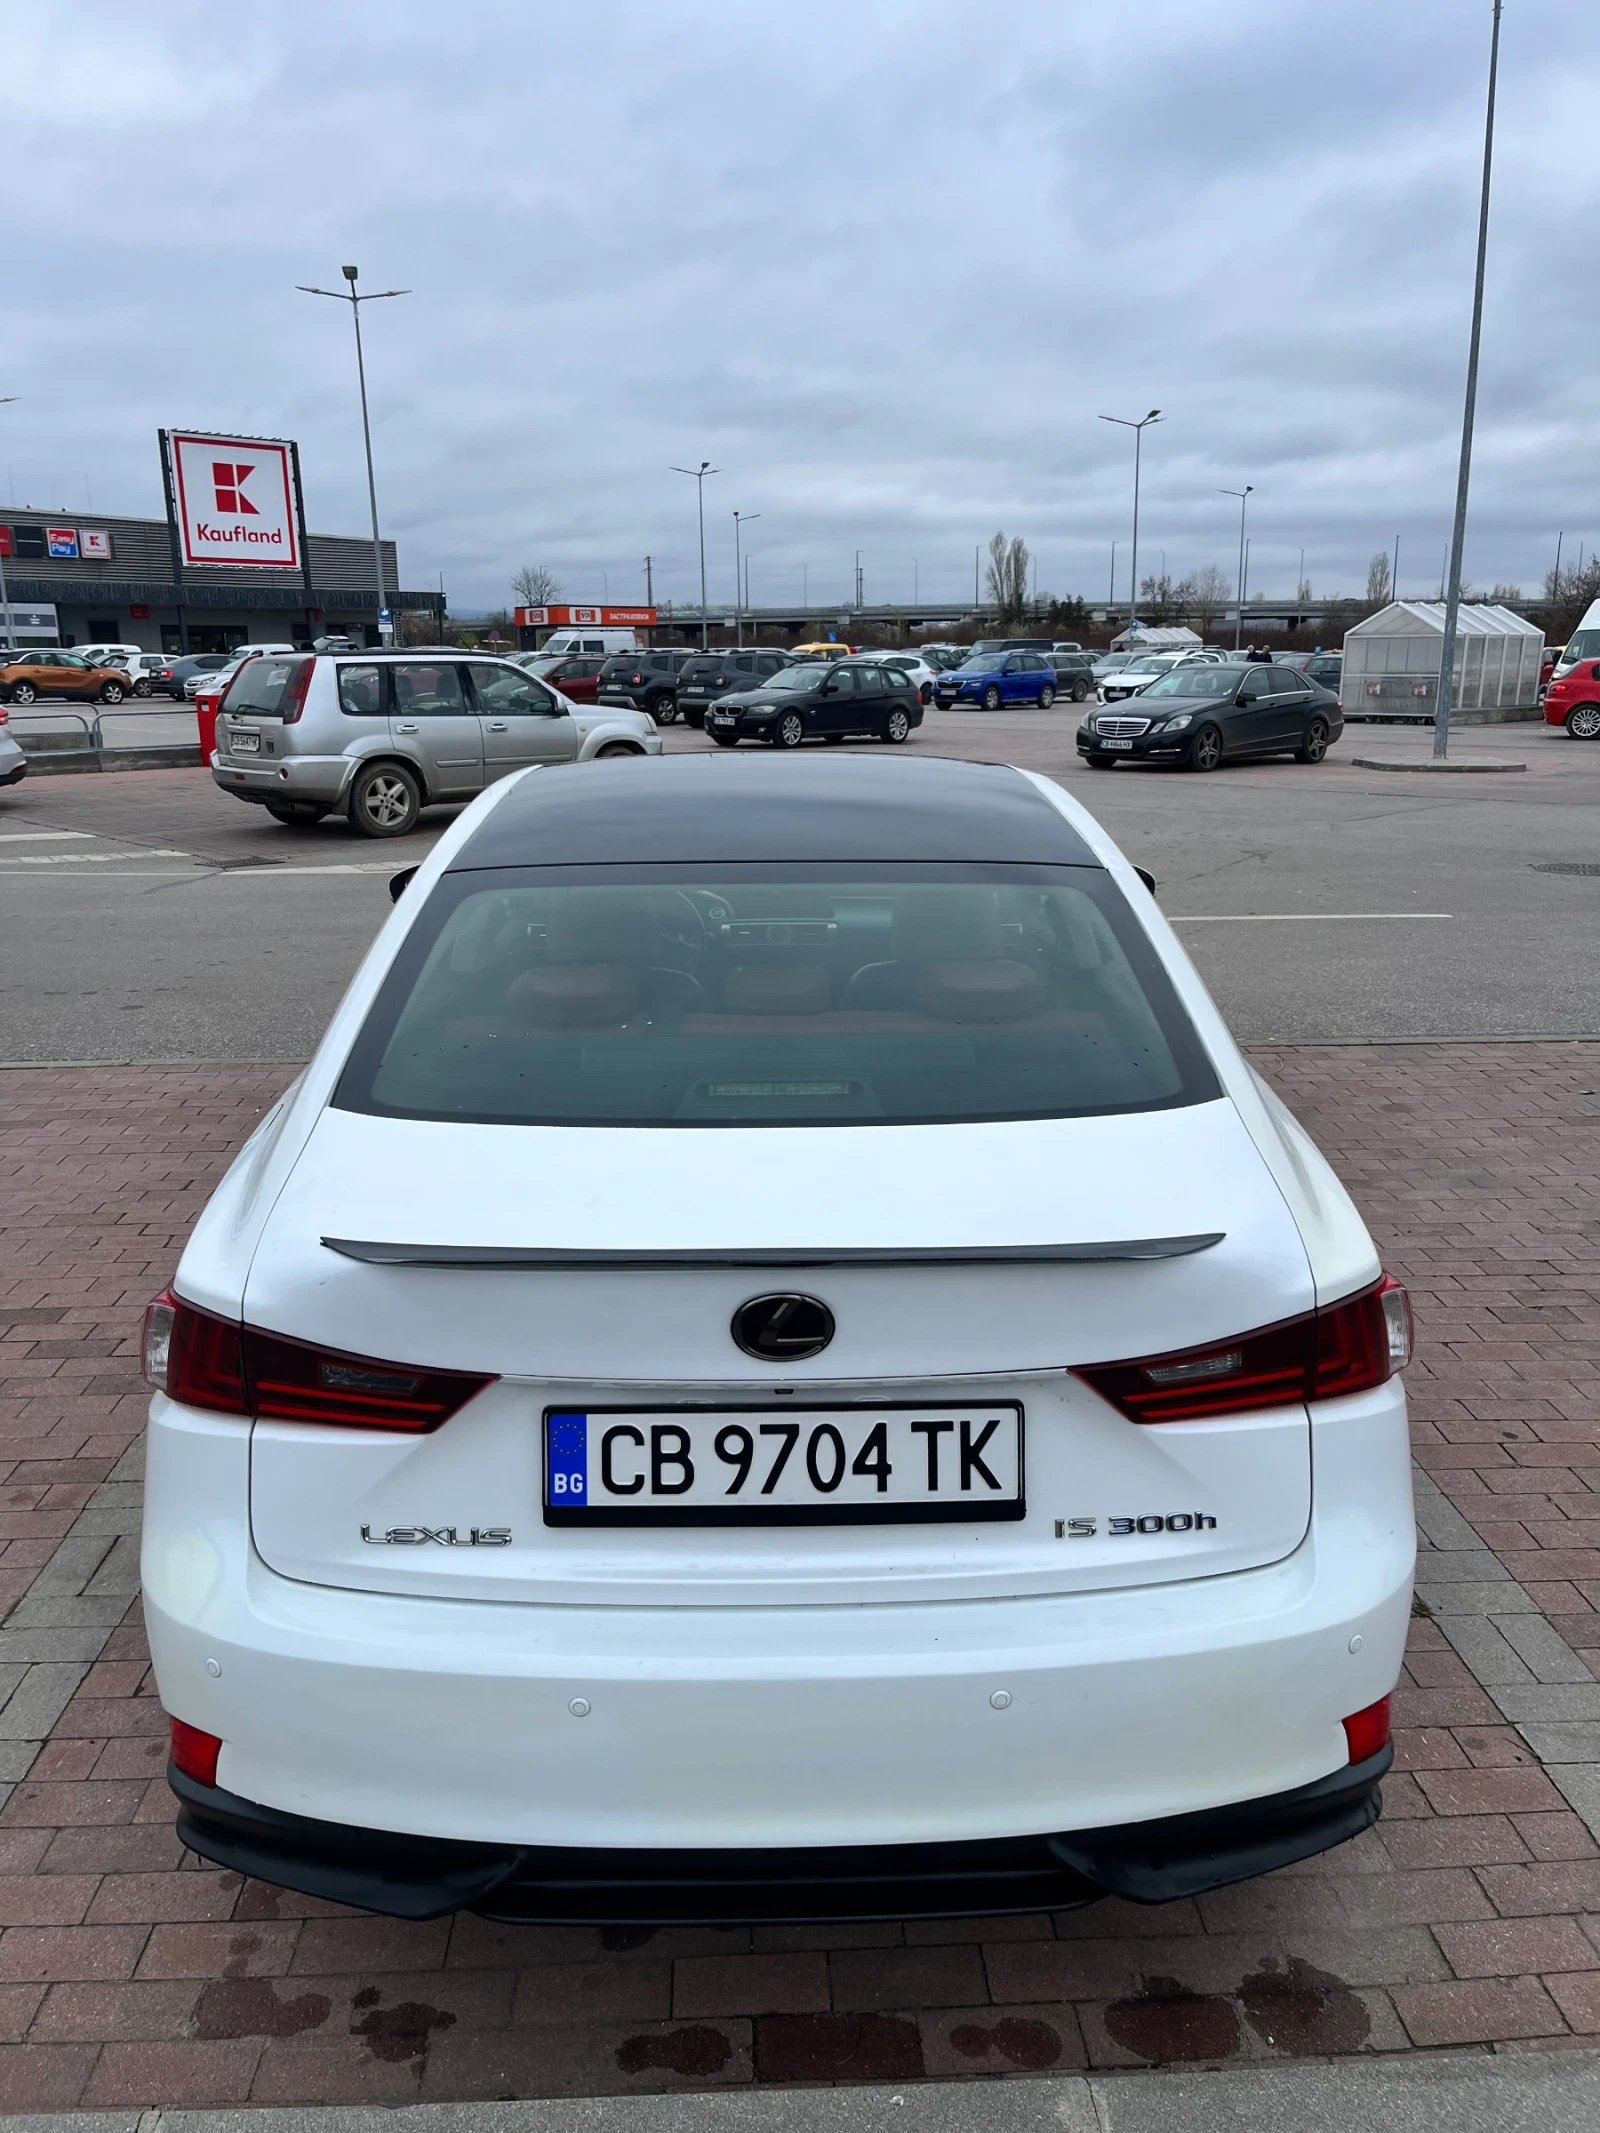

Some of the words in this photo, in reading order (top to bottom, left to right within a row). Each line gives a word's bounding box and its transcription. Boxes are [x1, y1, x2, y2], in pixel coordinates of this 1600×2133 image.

[50, 533, 74, 544] Easy
[197, 523, 282, 544] Kaufland
[52, 543, 71, 554] Pay
[601, 1424, 695, 1496] CB
[713, 1422, 893, 1495] 9704
[910, 1419, 1002, 1492] TK
[554, 1473, 583, 1495] BG
[360, 1524, 513, 1547] LEXUS
[1054, 1516, 1097, 1539] IS
[1108, 1510, 1217, 1536] 300h
